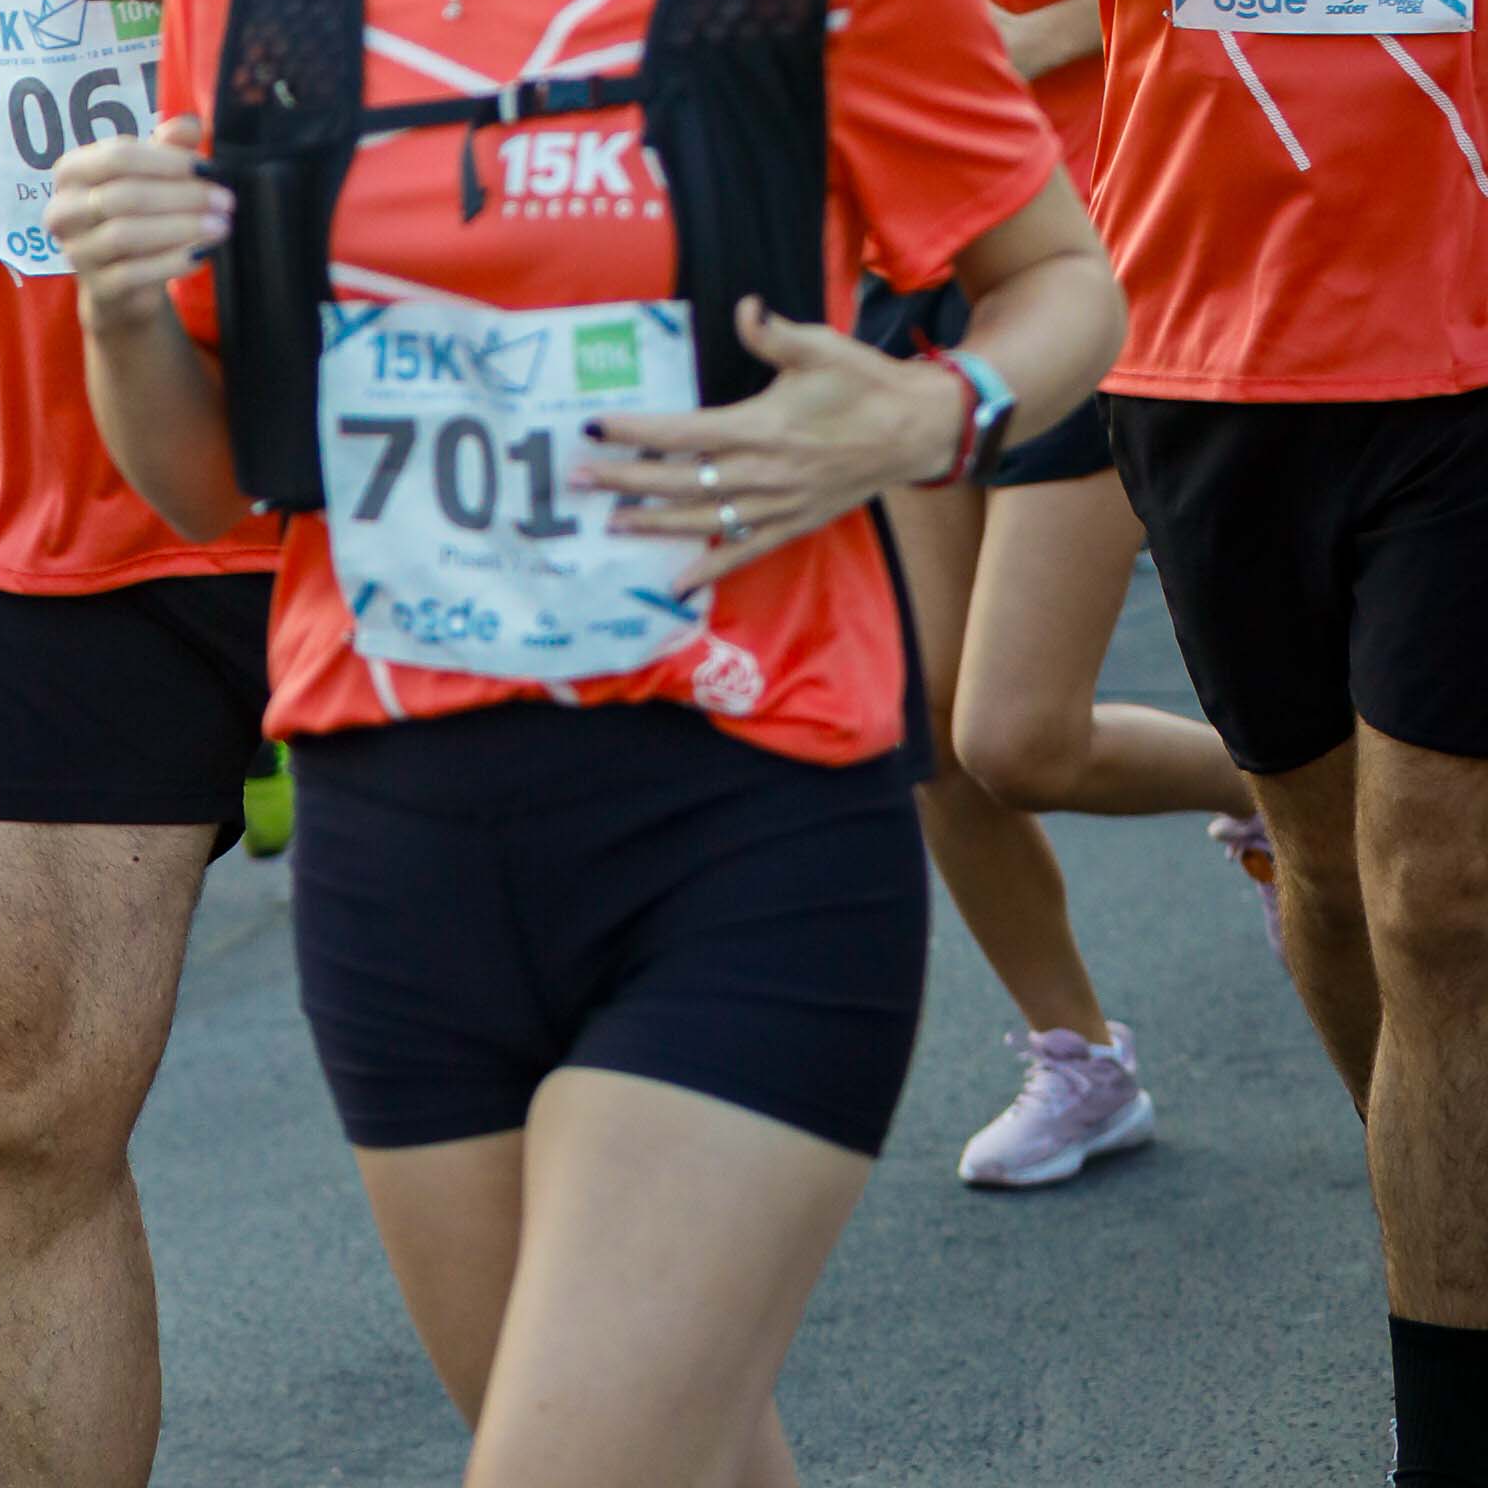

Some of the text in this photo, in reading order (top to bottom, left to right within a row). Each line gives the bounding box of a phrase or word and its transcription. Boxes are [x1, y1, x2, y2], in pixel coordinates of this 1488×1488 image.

[16, 181, 39, 201] De
[498, 131, 636, 198] 15K
[367, 330, 465, 381] 15K
[337, 415, 664, 539] 701
